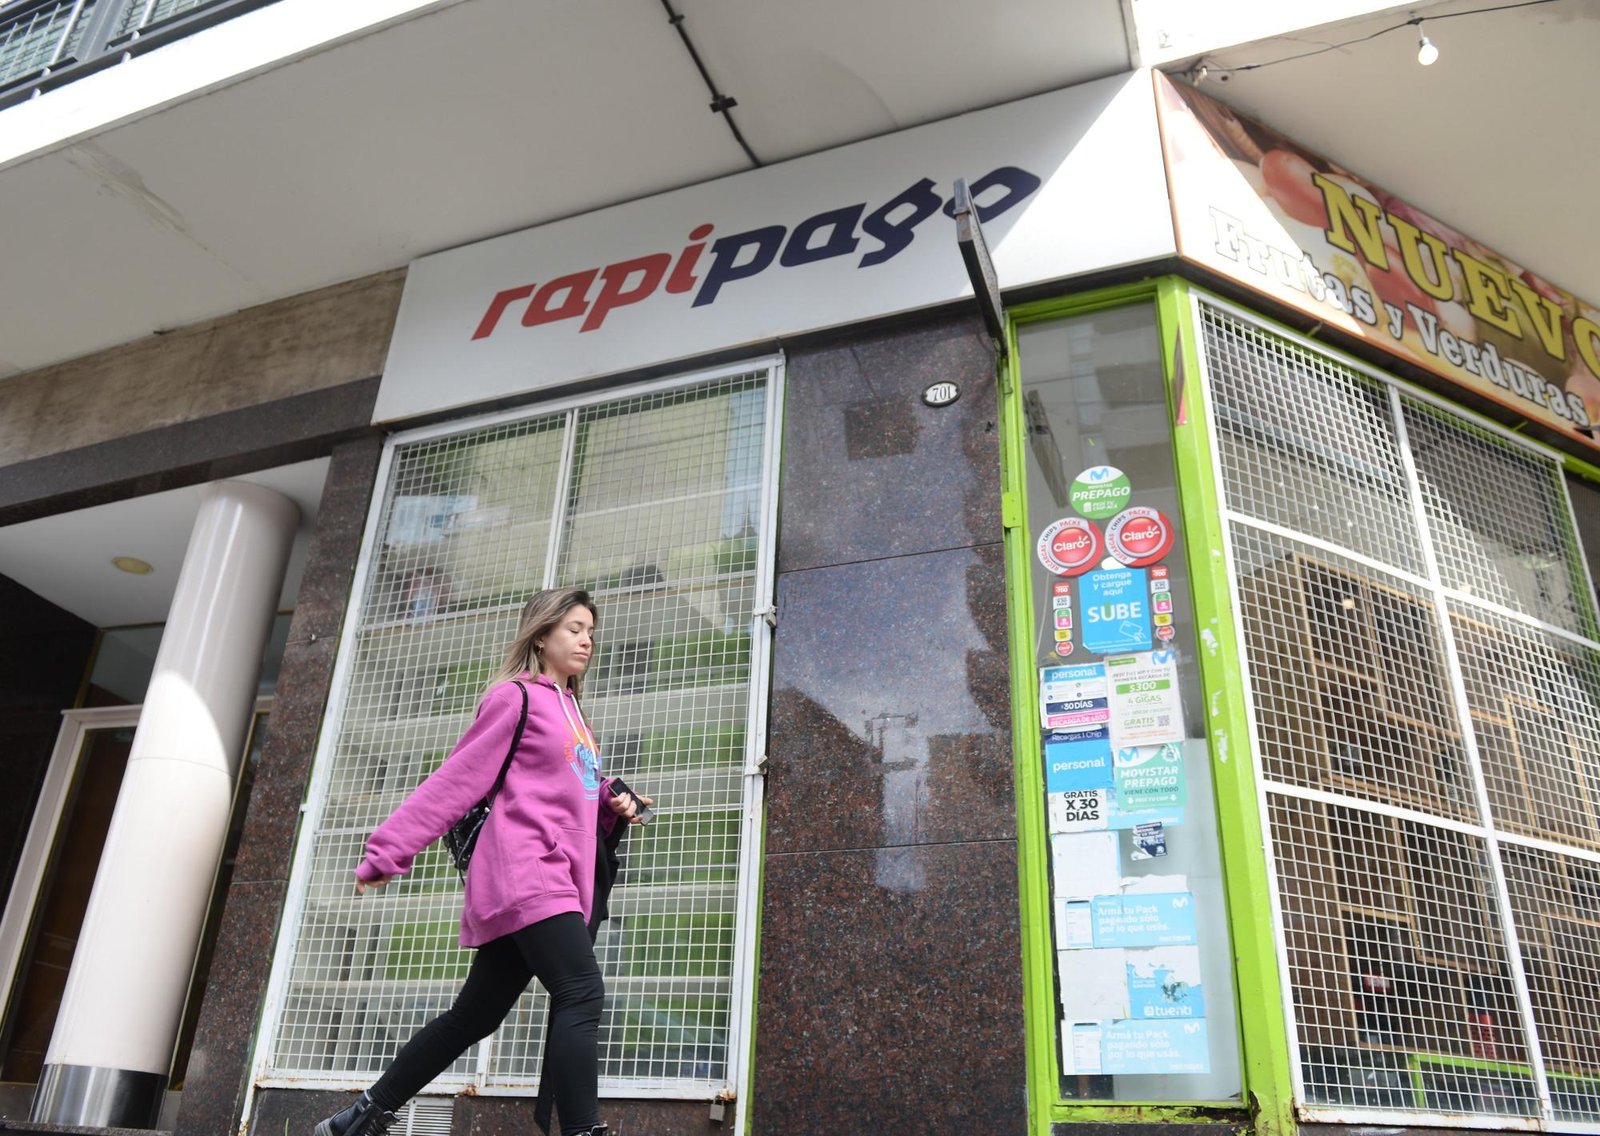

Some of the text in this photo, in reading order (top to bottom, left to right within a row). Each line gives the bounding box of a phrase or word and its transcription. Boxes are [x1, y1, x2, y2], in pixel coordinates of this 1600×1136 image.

[471, 166, 1042, 340] rapipago
[1209, 205, 1590, 428] Frutas y Verduras
[932, 385, 951, 401] 701
[1072, 486, 1131, 502] PREPAGO
[1121, 528, 1156, 542] Claro
[1053, 538, 1086, 552] Claro
[1092, 571, 1132, 582] Obtenga
[1093, 579, 1132, 591] y cargue
[1103, 588, 1124, 597] aquí
[1087, 601, 1142, 623] SUBE
[1052, 667, 1097, 680] personal
[1129, 681, 1156, 692] $300
[1074, 699, 1093, 710] DÍAS
[1135, 694, 1161, 704] GIGAS
[1124, 717, 1154, 726] GRATIS
[1052, 733, 1081, 742] Recargas
[1086, 731, 1102, 739] Chip
[1052, 756, 1105, 773] personal
[1120, 766, 1178, 778] MOVISTAR
[1124, 776, 1177, 789] PREPAGO
[1064, 790, 1098, 799] GRATIS
[1066, 798, 1098, 811] X 30
[1066, 809, 1099, 822] DÍAS
[1136, 904, 1158, 914] Pack
[1099, 927, 1115, 935] por
[1127, 925, 1144, 933] que
[1155, 1006, 1192, 1017] tuenti
[1146, 1030, 1168, 1038] Pack
[1108, 1051, 1123, 1059] por
[1136, 1050, 1153, 1059] que
